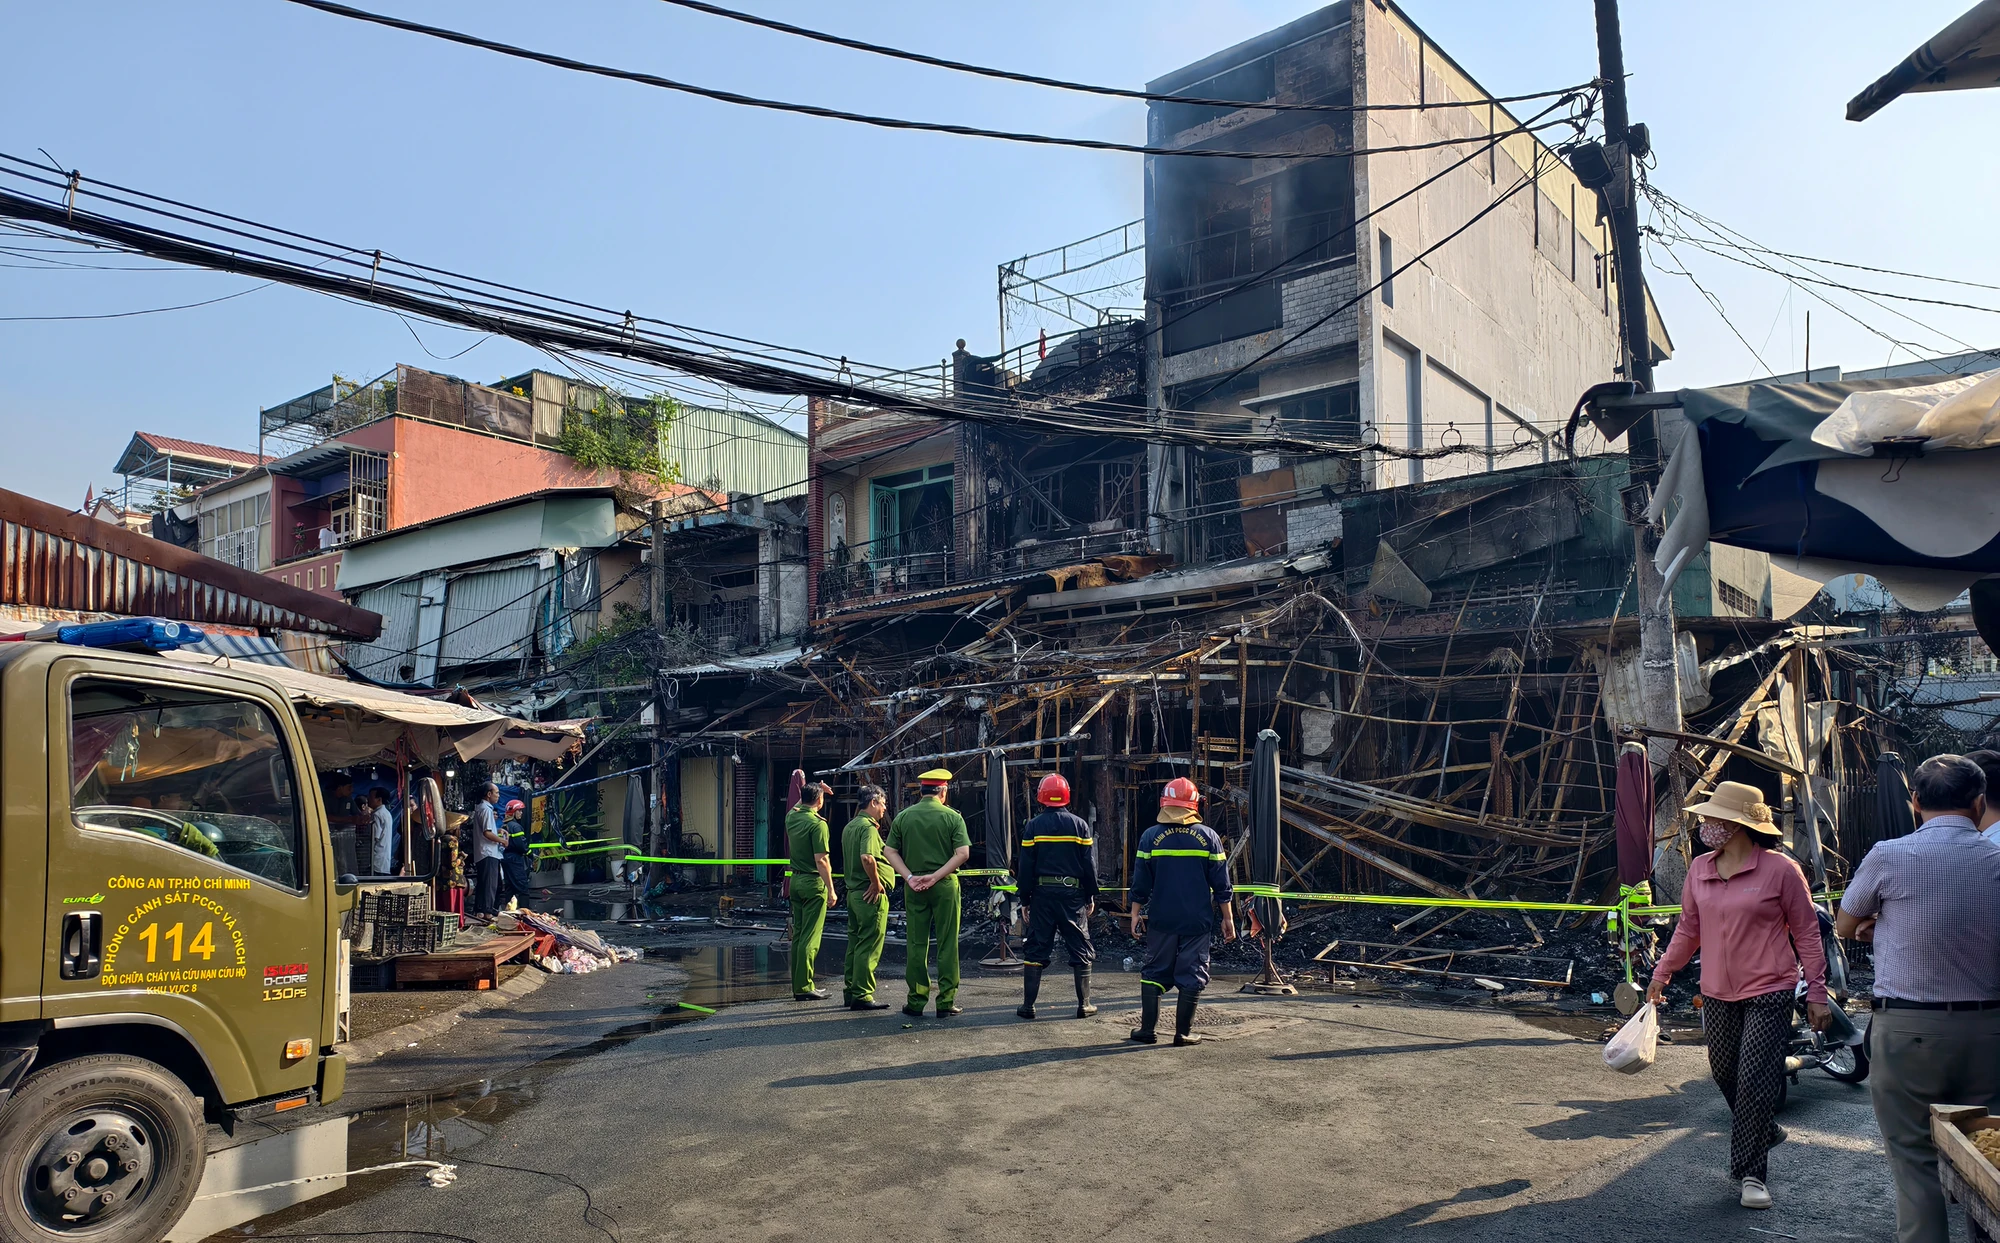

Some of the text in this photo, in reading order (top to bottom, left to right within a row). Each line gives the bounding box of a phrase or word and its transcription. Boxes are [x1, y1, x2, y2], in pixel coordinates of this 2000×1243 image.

[108, 874, 145, 889] CÔNG
[147, 877, 165, 889] AN
[203, 875, 222, 889] CHÍ
[224, 878, 251, 889] MINH
[103, 924, 130, 972] PHÒNG
[164, 890, 190, 904] SÁT
[192, 894, 223, 915] PCCC
[222, 912, 237, 930] VÀ
[232, 930, 246, 965] CNCH
[138, 921, 216, 963] 114
[120, 971, 144, 984] CHỮA
[146, 969, 169, 982] CHÁY
[170, 968, 181, 981] VÀ
[182, 967, 200, 980] CỨU
[200, 969, 217, 981] NẠN
[218, 966, 235, 978] CỨU
[263, 963, 309, 977] ISUZU
[263, 974, 308, 987] D-CORE
[146, 983, 198, 996] KHU VỰC 8
